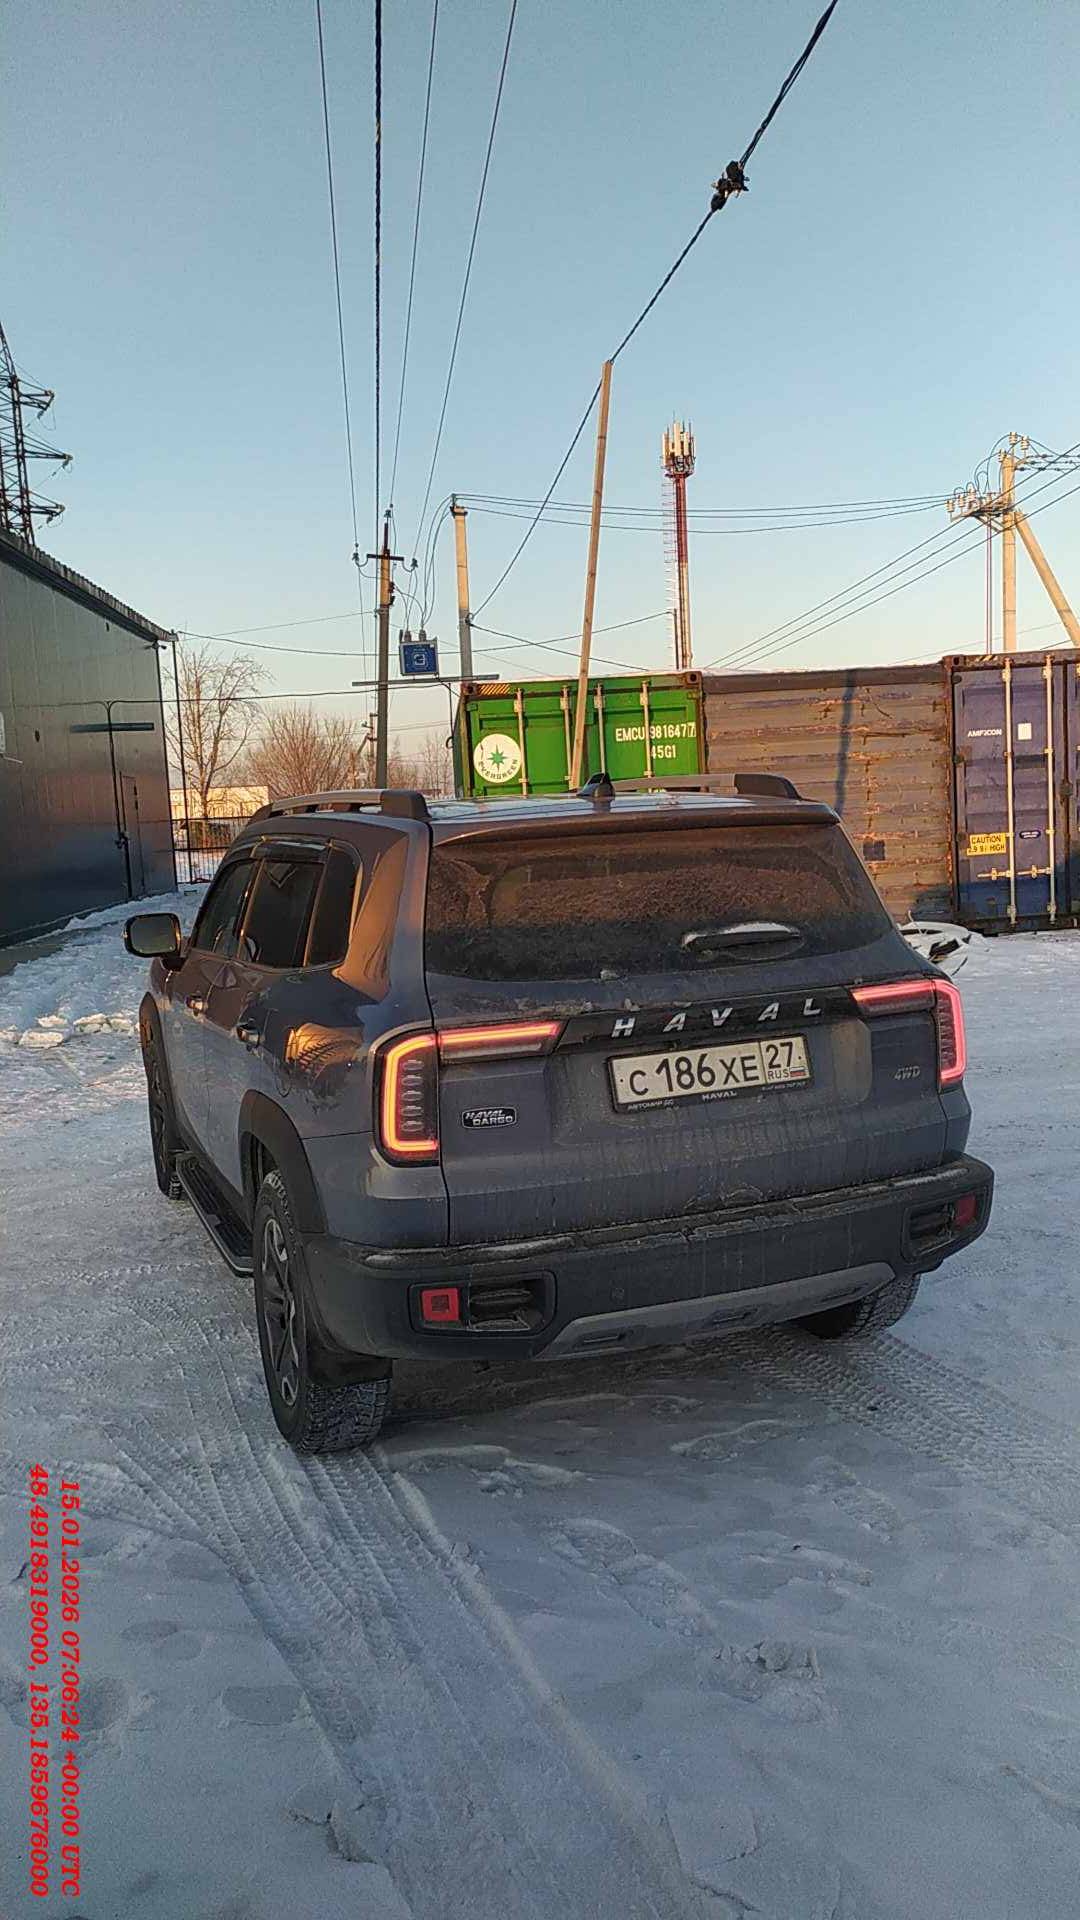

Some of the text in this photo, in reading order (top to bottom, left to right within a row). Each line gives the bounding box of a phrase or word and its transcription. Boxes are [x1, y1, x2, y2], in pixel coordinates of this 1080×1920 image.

[615, 721, 697, 742] EMCU 9816477
[651, 744, 676, 759] 45G1
[971, 834, 1001, 844] CAUTION
[611, 998, 822, 1038] HAVAL
[765, 1042, 794, 1070] 27
[767, 1069, 790, 1081] RUS
[702, 1090, 737, 1101] HAVAL
[465, 1109, 506, 1120] HAVAL
[472, 1115, 513, 1126] DARGO
